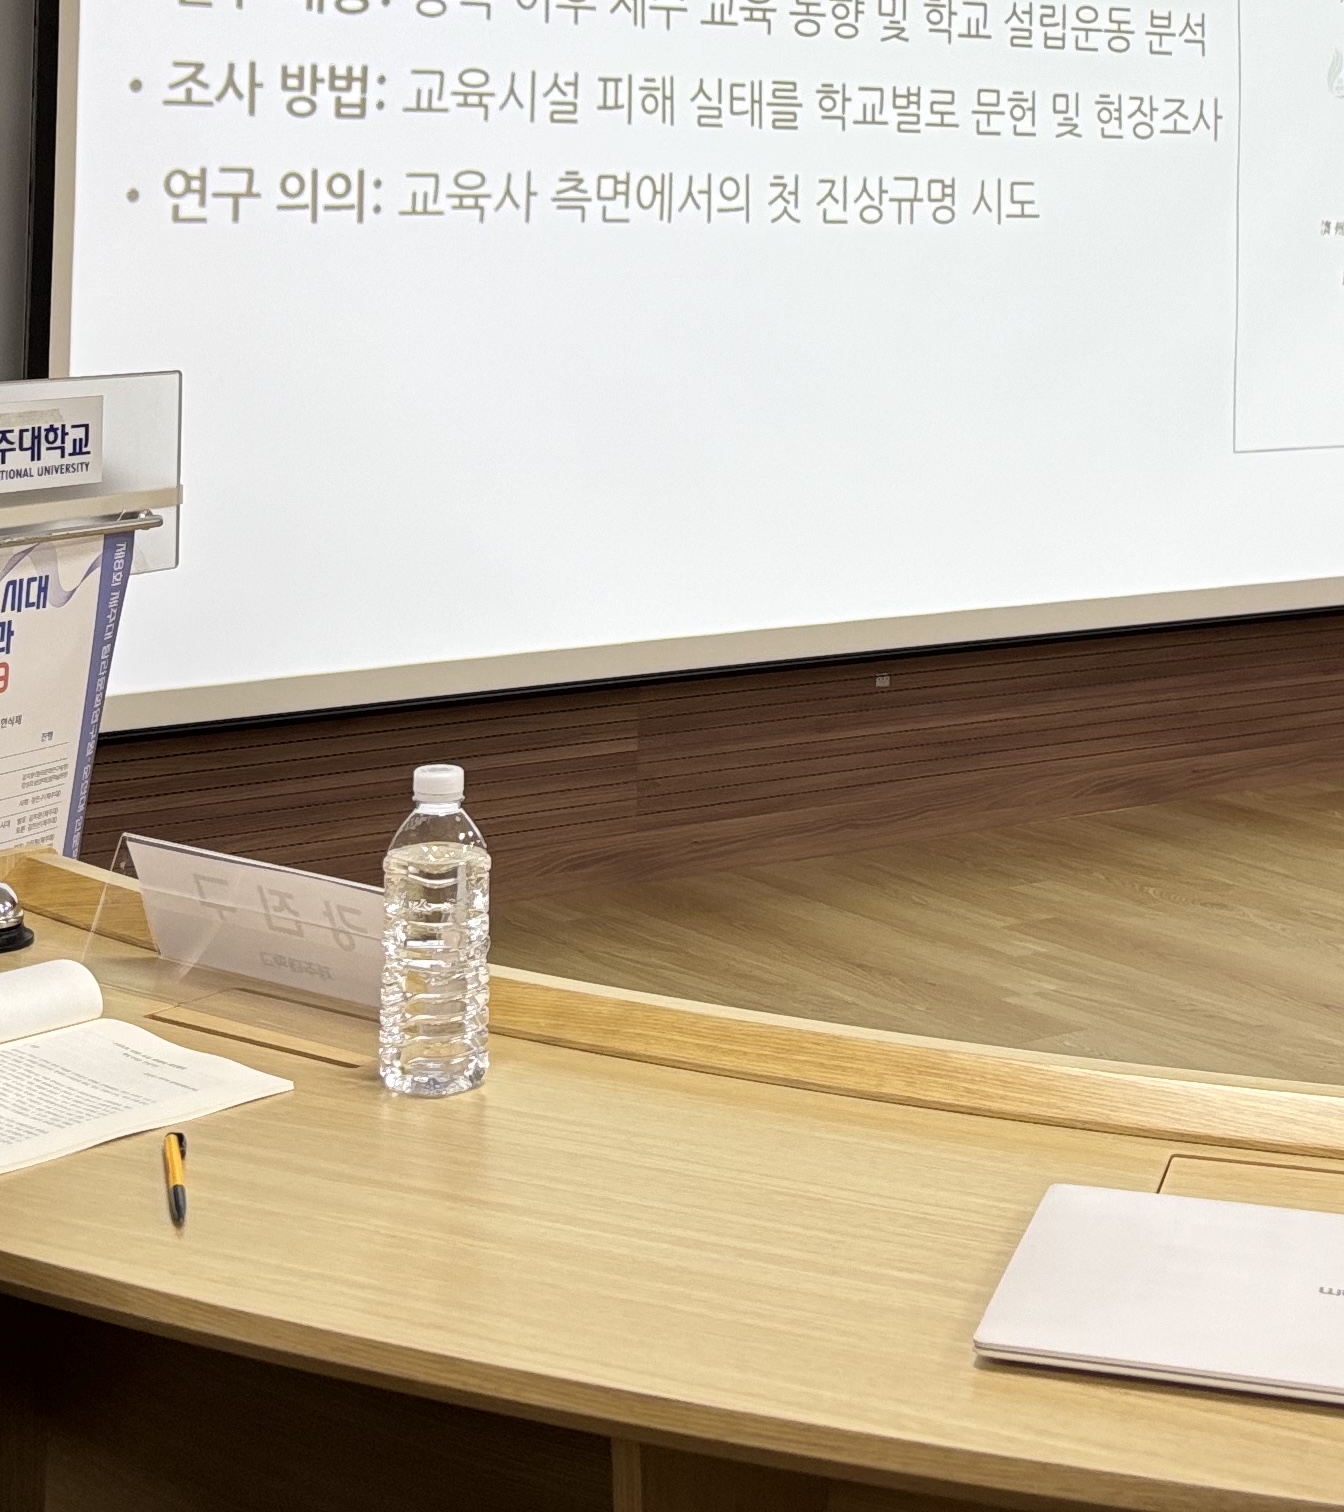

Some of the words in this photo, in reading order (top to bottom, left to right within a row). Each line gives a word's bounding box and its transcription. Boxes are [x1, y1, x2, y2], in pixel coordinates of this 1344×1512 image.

[1003, 1, 1136, 54] 설립운동
[1144, 9, 1206, 58] 분석
[162, 60, 264, 117] 조사
[280, 63, 387, 120] 방법:
[401, 67, 580, 125] 교육시설
[596, 73, 675, 127] 피해
[689, 77, 803, 131] 실태를
[815, 82, 960, 134] 학교별로
[970, 88, 1037, 137] 문헌
[1052, 91, 1083, 139] 및
[1094, 93, 1224, 142] 현장조사
[163, 166, 262, 224] 연구
[275, 167, 383, 225] 의의:
[397, 169, 539, 225] 교육사
[550, 170, 750, 225] 측면에서의
[767, 173, 801, 224] 첫
[815, 175, 956, 226] 진상규명
[972, 177, 1041, 226] 시도
[37, 461, 91, 478] UNIVERSITY
[111, 542, 127, 586] 제8회
[1, 575, 49, 613] 시대
[104, 591, 120, 641] 제주대
